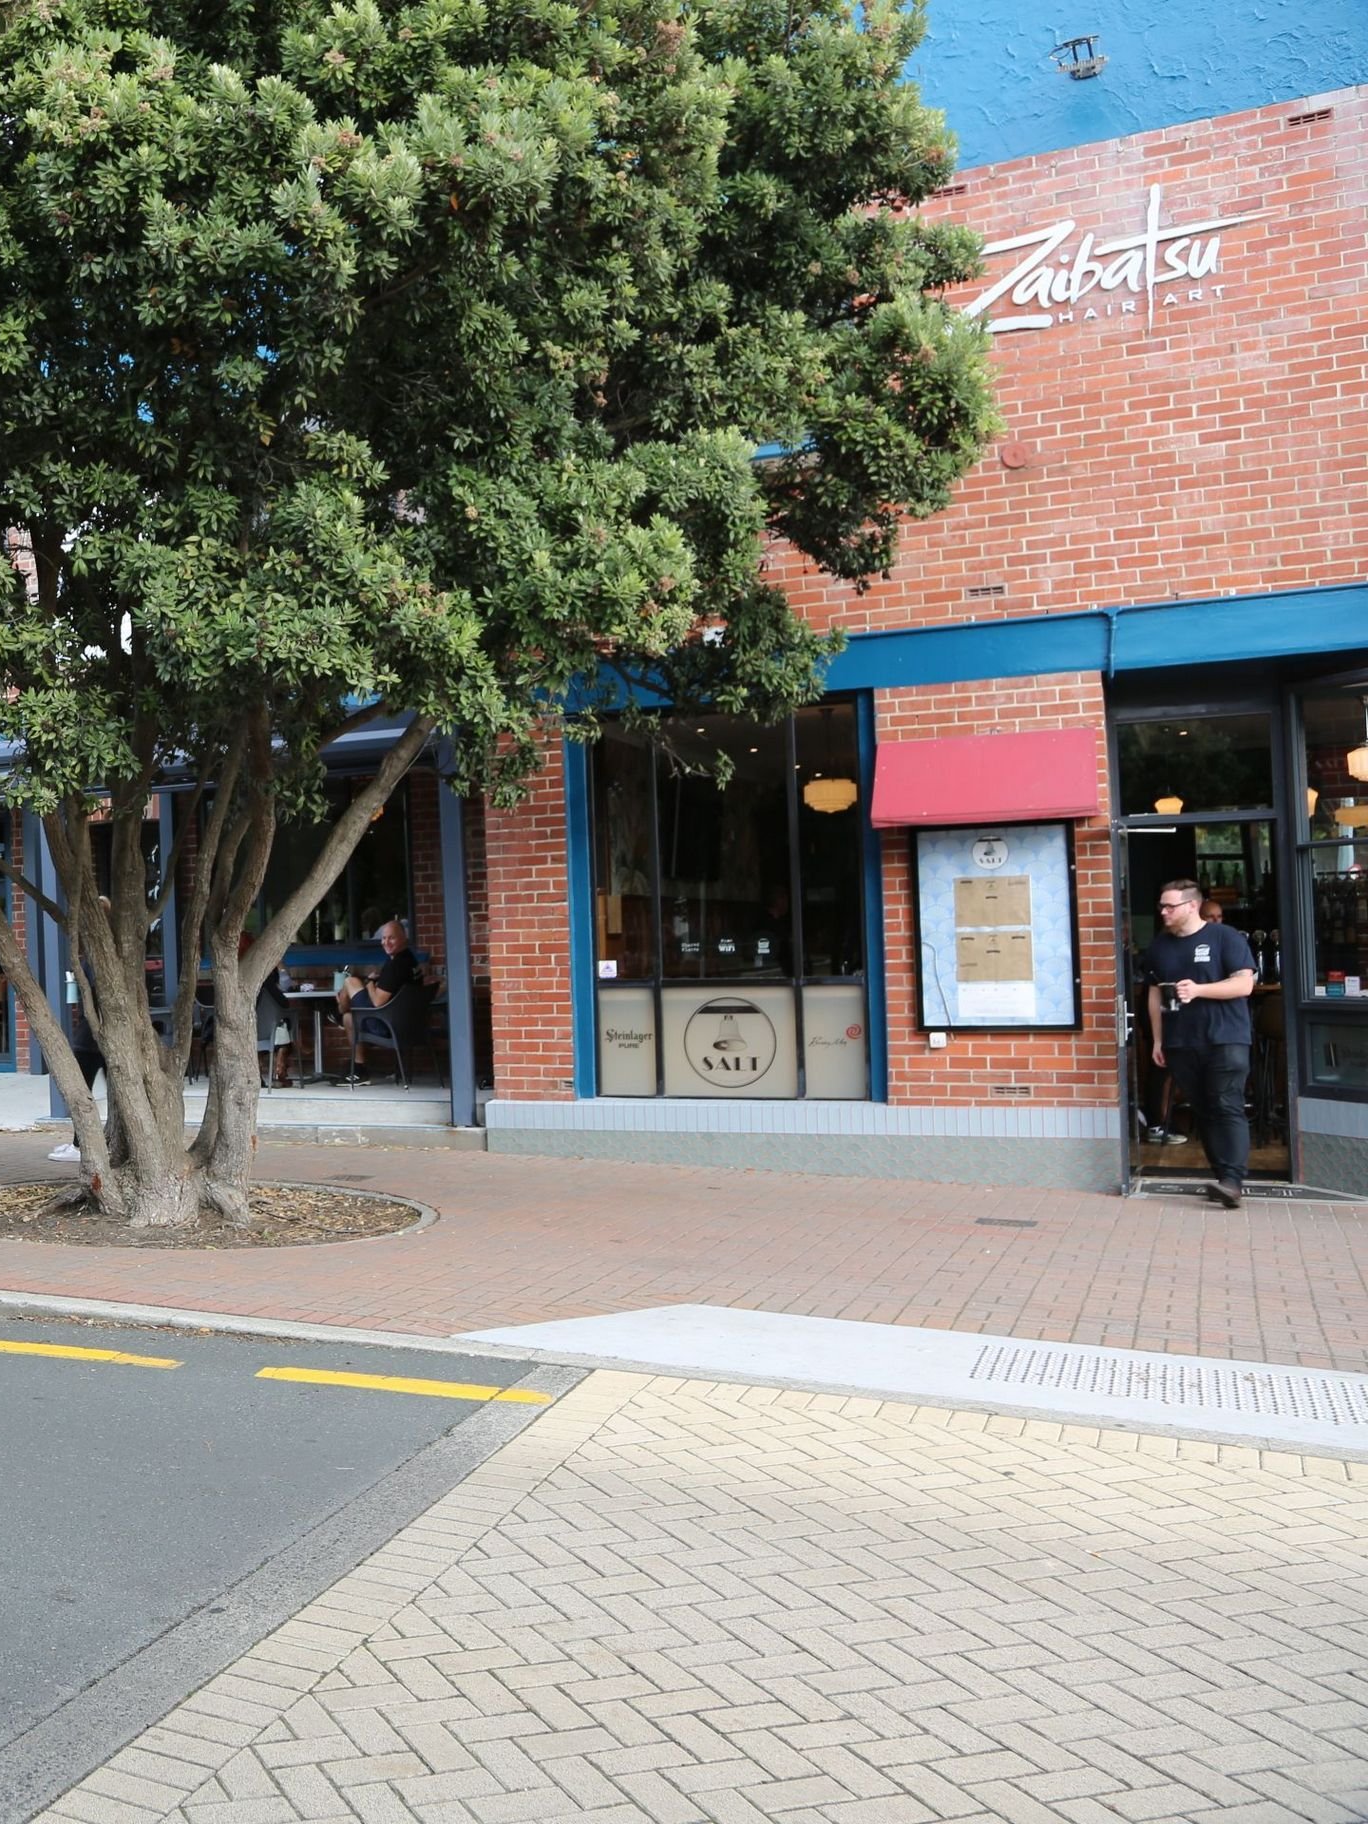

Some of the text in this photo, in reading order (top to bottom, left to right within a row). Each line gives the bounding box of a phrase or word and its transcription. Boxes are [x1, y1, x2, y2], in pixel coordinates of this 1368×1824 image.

[956, 183, 1280, 334] Zaibatsu
[1059, 284, 1226, 322] HAIR ART
[605, 1029, 653, 1042] Steinlager
[702, 1056, 760, 1071] SALT
